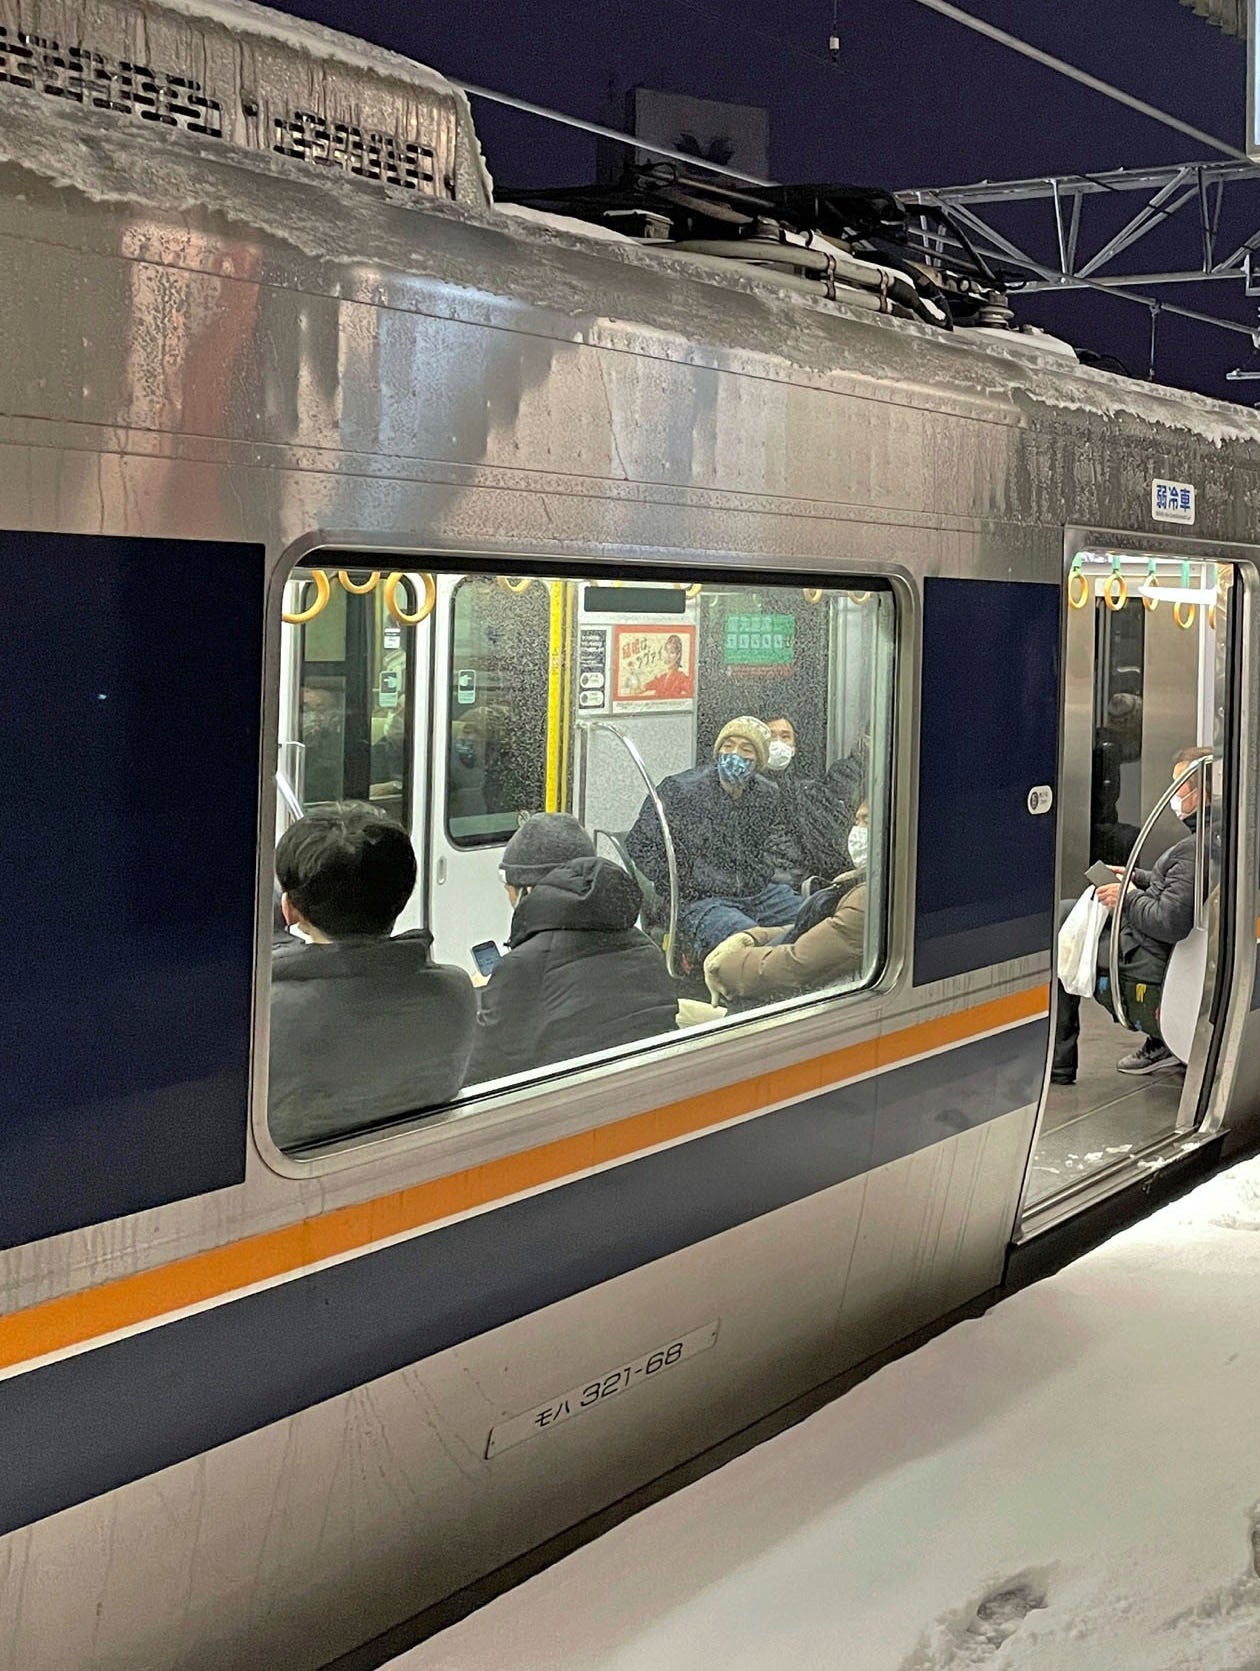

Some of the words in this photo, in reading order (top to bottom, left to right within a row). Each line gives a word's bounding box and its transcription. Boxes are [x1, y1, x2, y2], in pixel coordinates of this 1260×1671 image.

[1156, 485, 1191, 512] 弱冷車
[535, 1400, 570, 1428] モハ
[580, 1343, 684, 1407] 321-68
